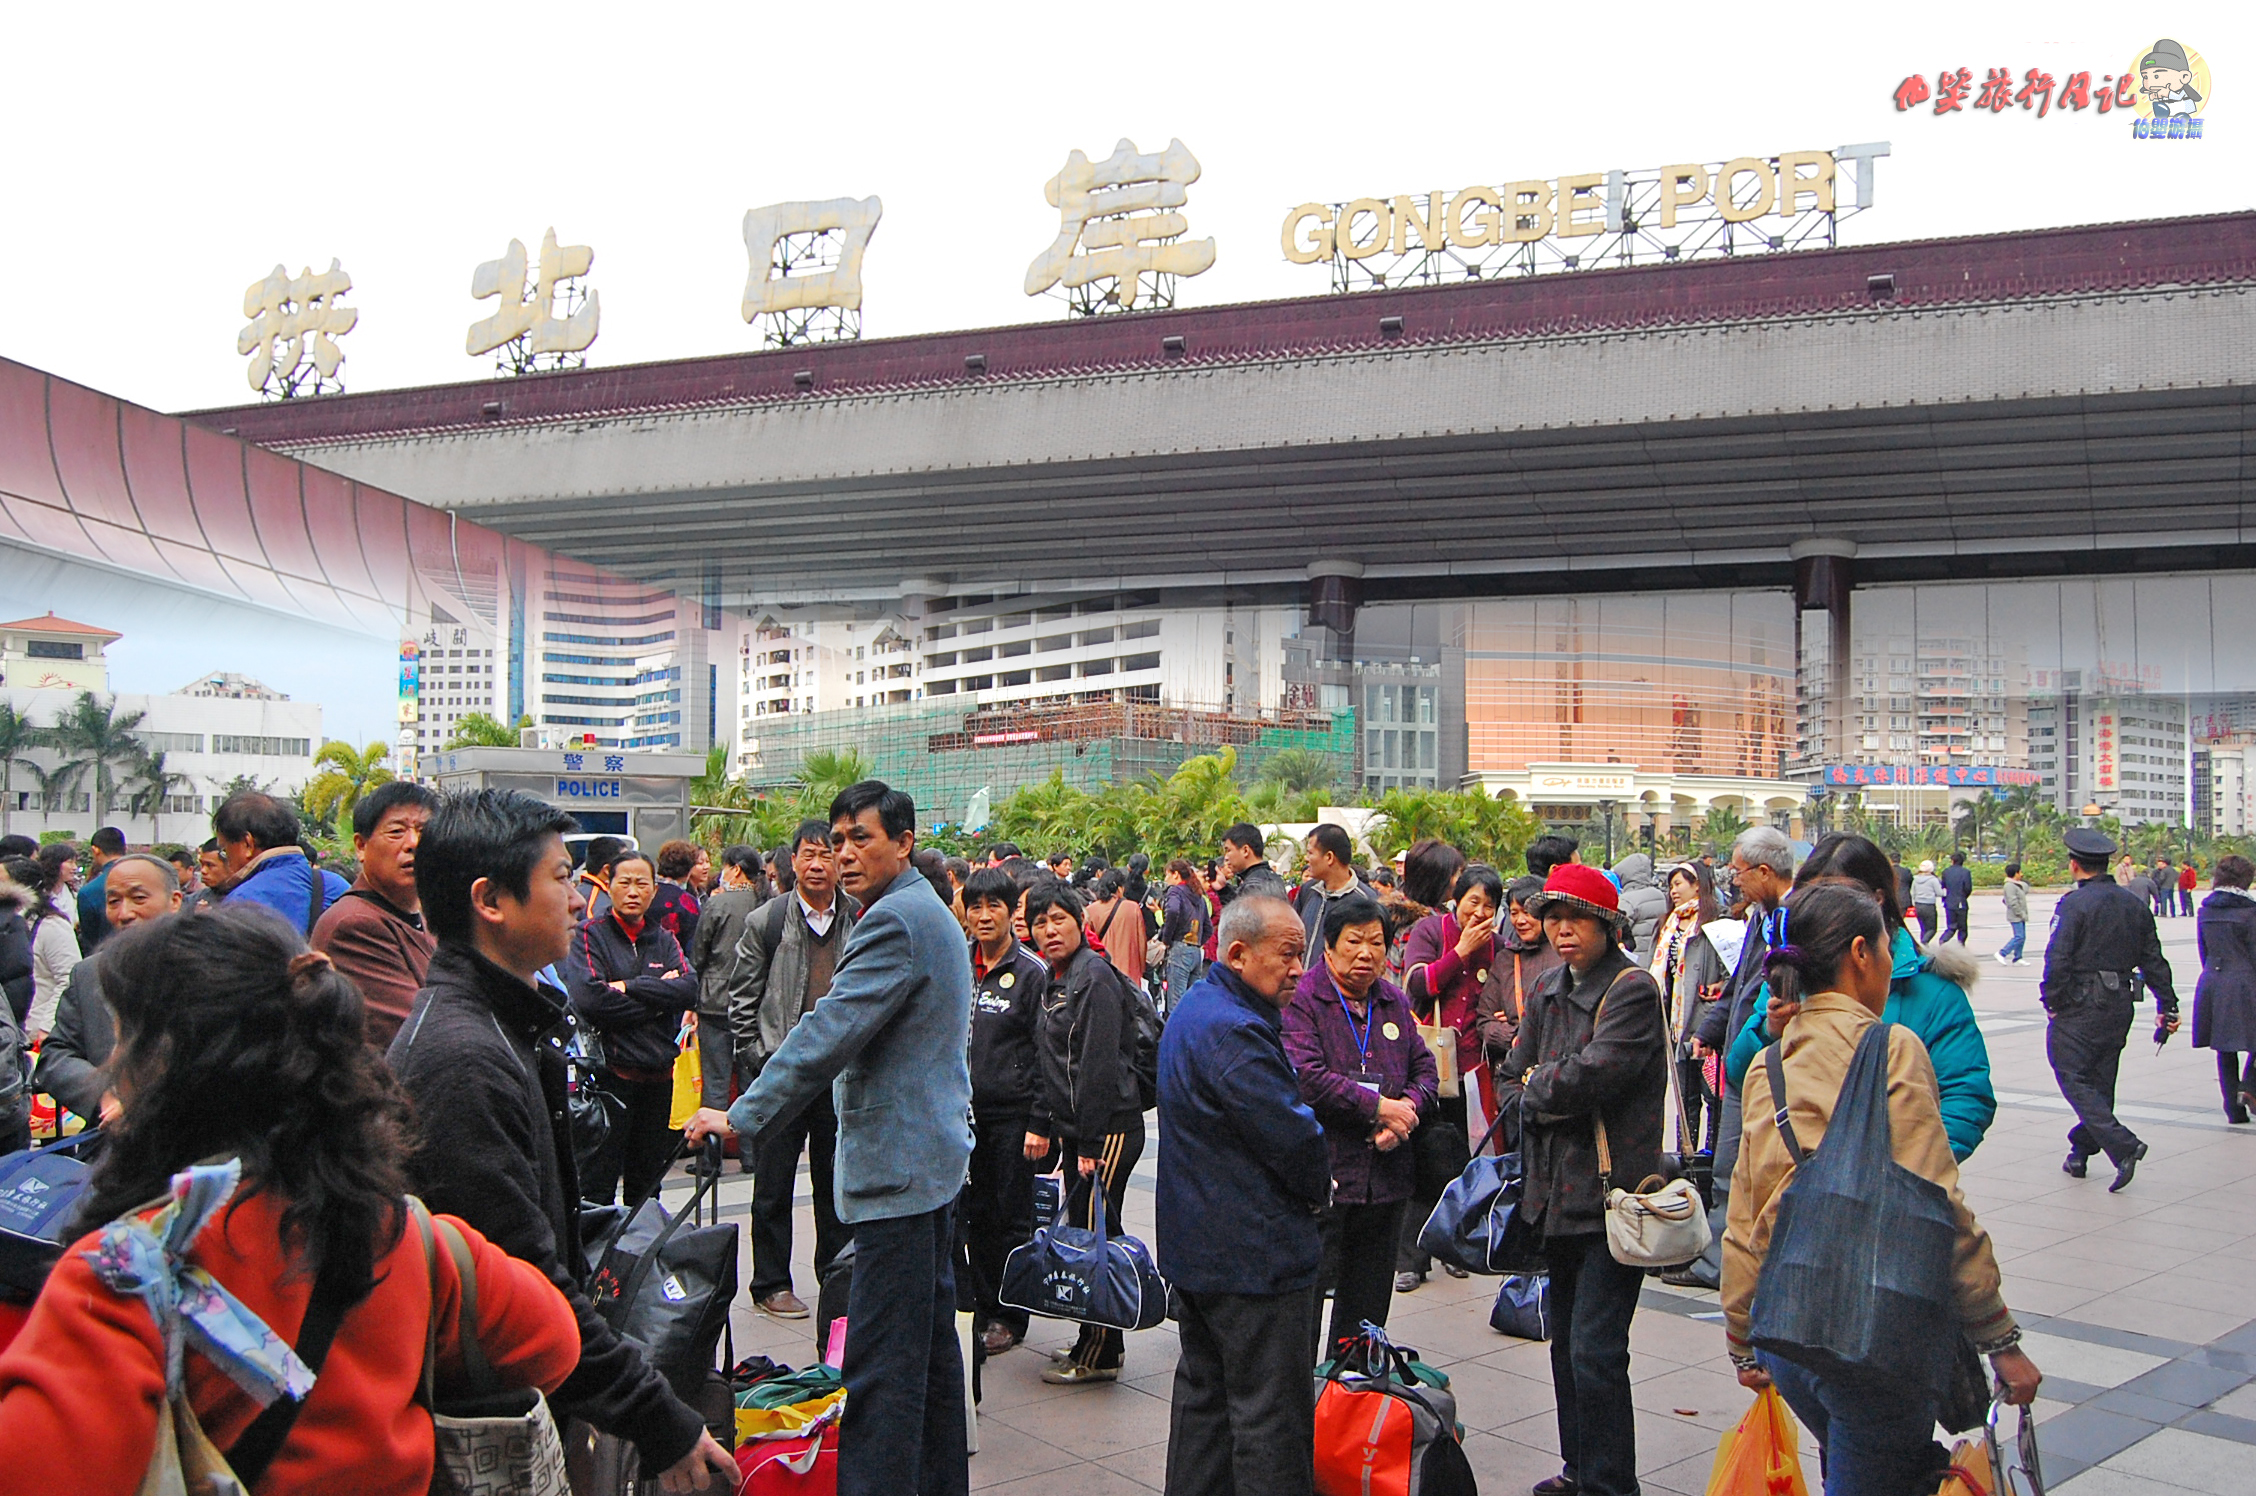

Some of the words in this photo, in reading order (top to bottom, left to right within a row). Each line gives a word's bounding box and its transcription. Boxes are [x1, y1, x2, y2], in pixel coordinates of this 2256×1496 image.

[1281, 168, 1624, 264] GONGBEI
[1660, 141, 1892, 229] PORT
[237, 137, 1216, 391] 拱北口岸
[557, 781, 620, 798] POLICE
[563, 753, 624, 772] 警察
